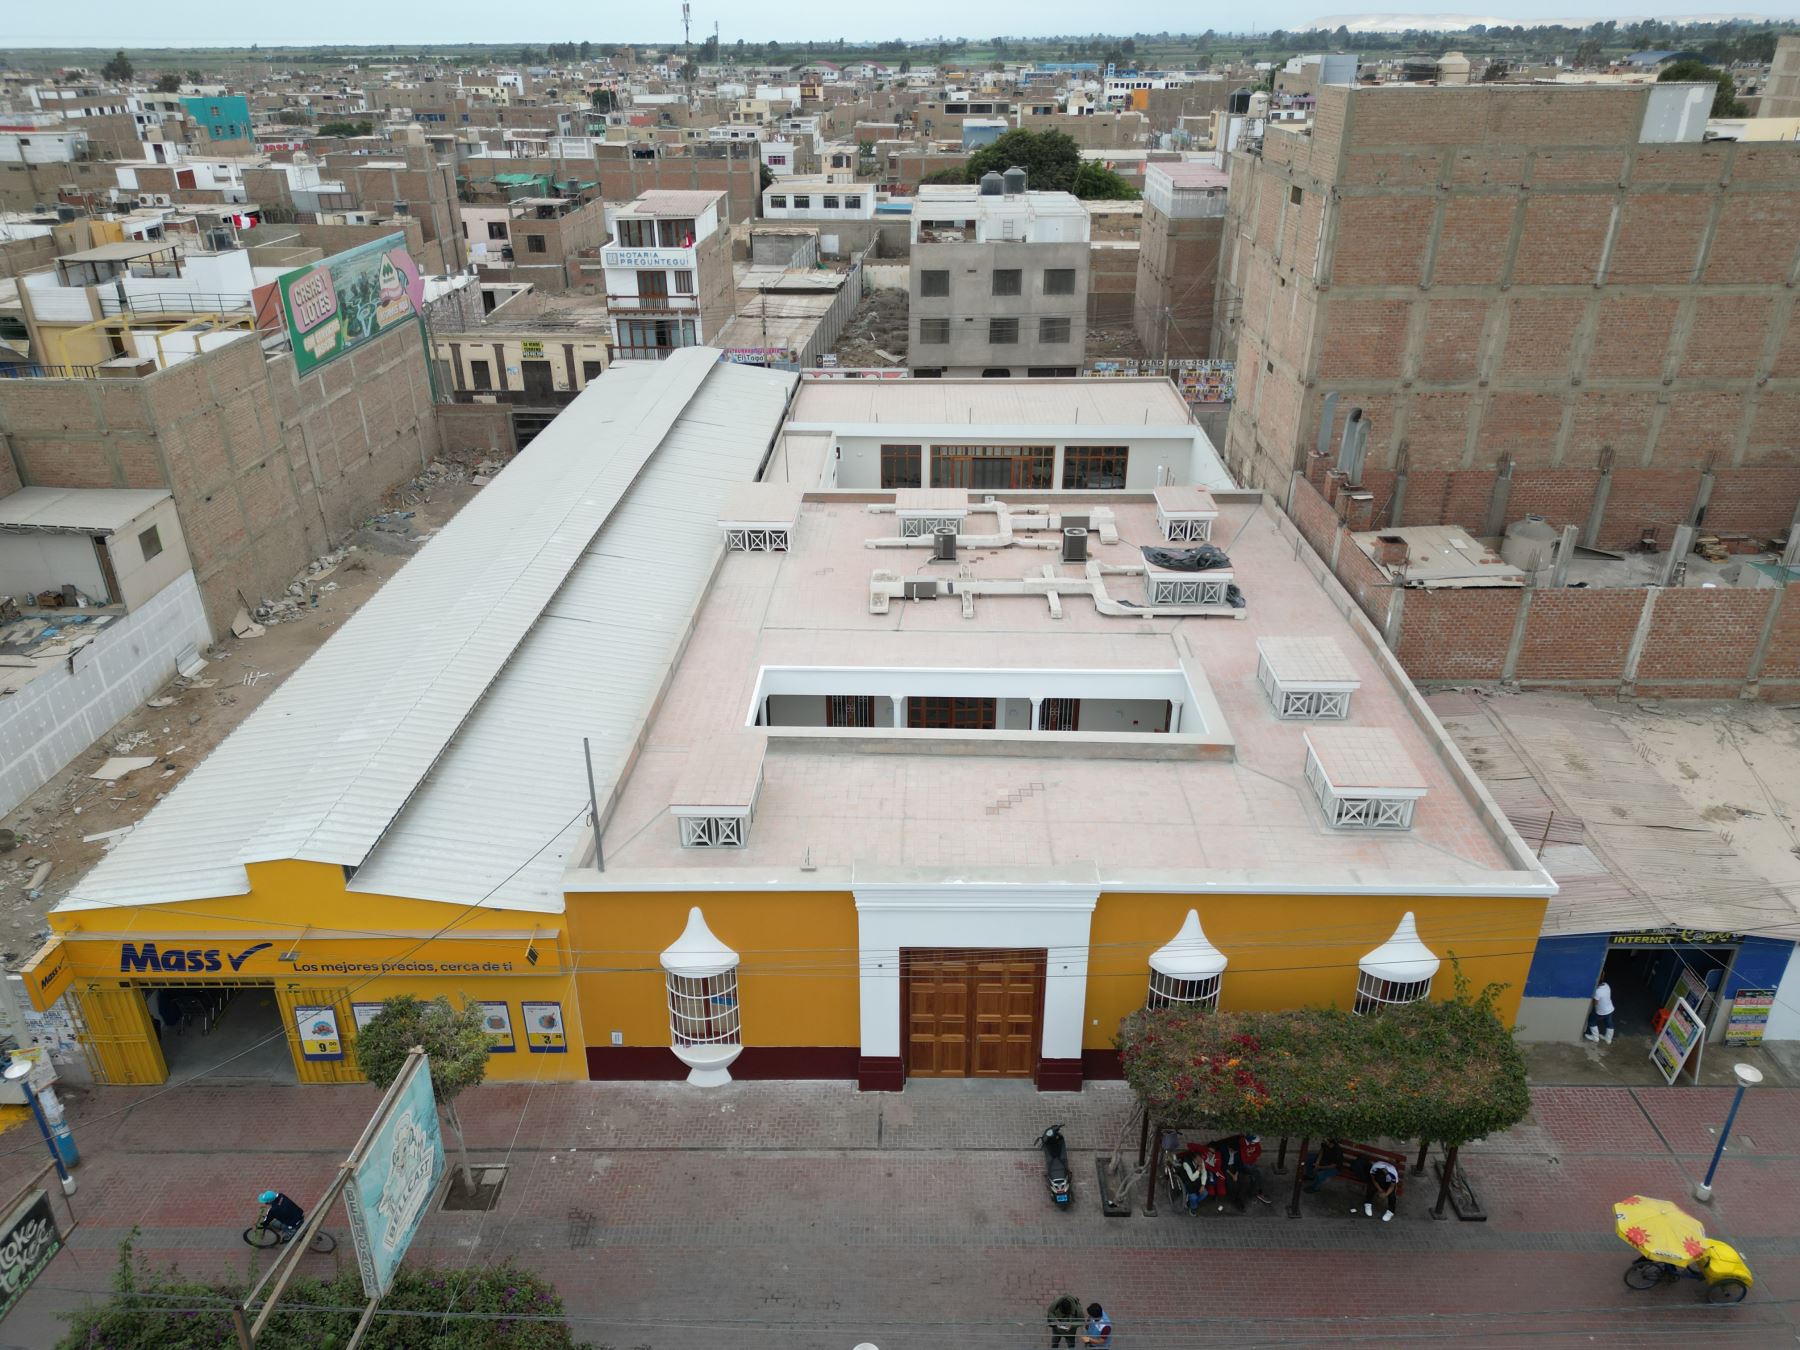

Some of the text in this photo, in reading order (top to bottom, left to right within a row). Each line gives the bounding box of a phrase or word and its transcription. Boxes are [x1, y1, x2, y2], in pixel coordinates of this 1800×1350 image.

[294, 274, 321, 307] CASAS
[300, 291, 330, 327] LOTES
[1613, 935, 1675, 944] INTERNET
[120, 943, 222, 972] Mass
[293, 961, 513, 973] Los mejores precios, cerca de ti
[345, 1189, 374, 1286] BELLCAST
